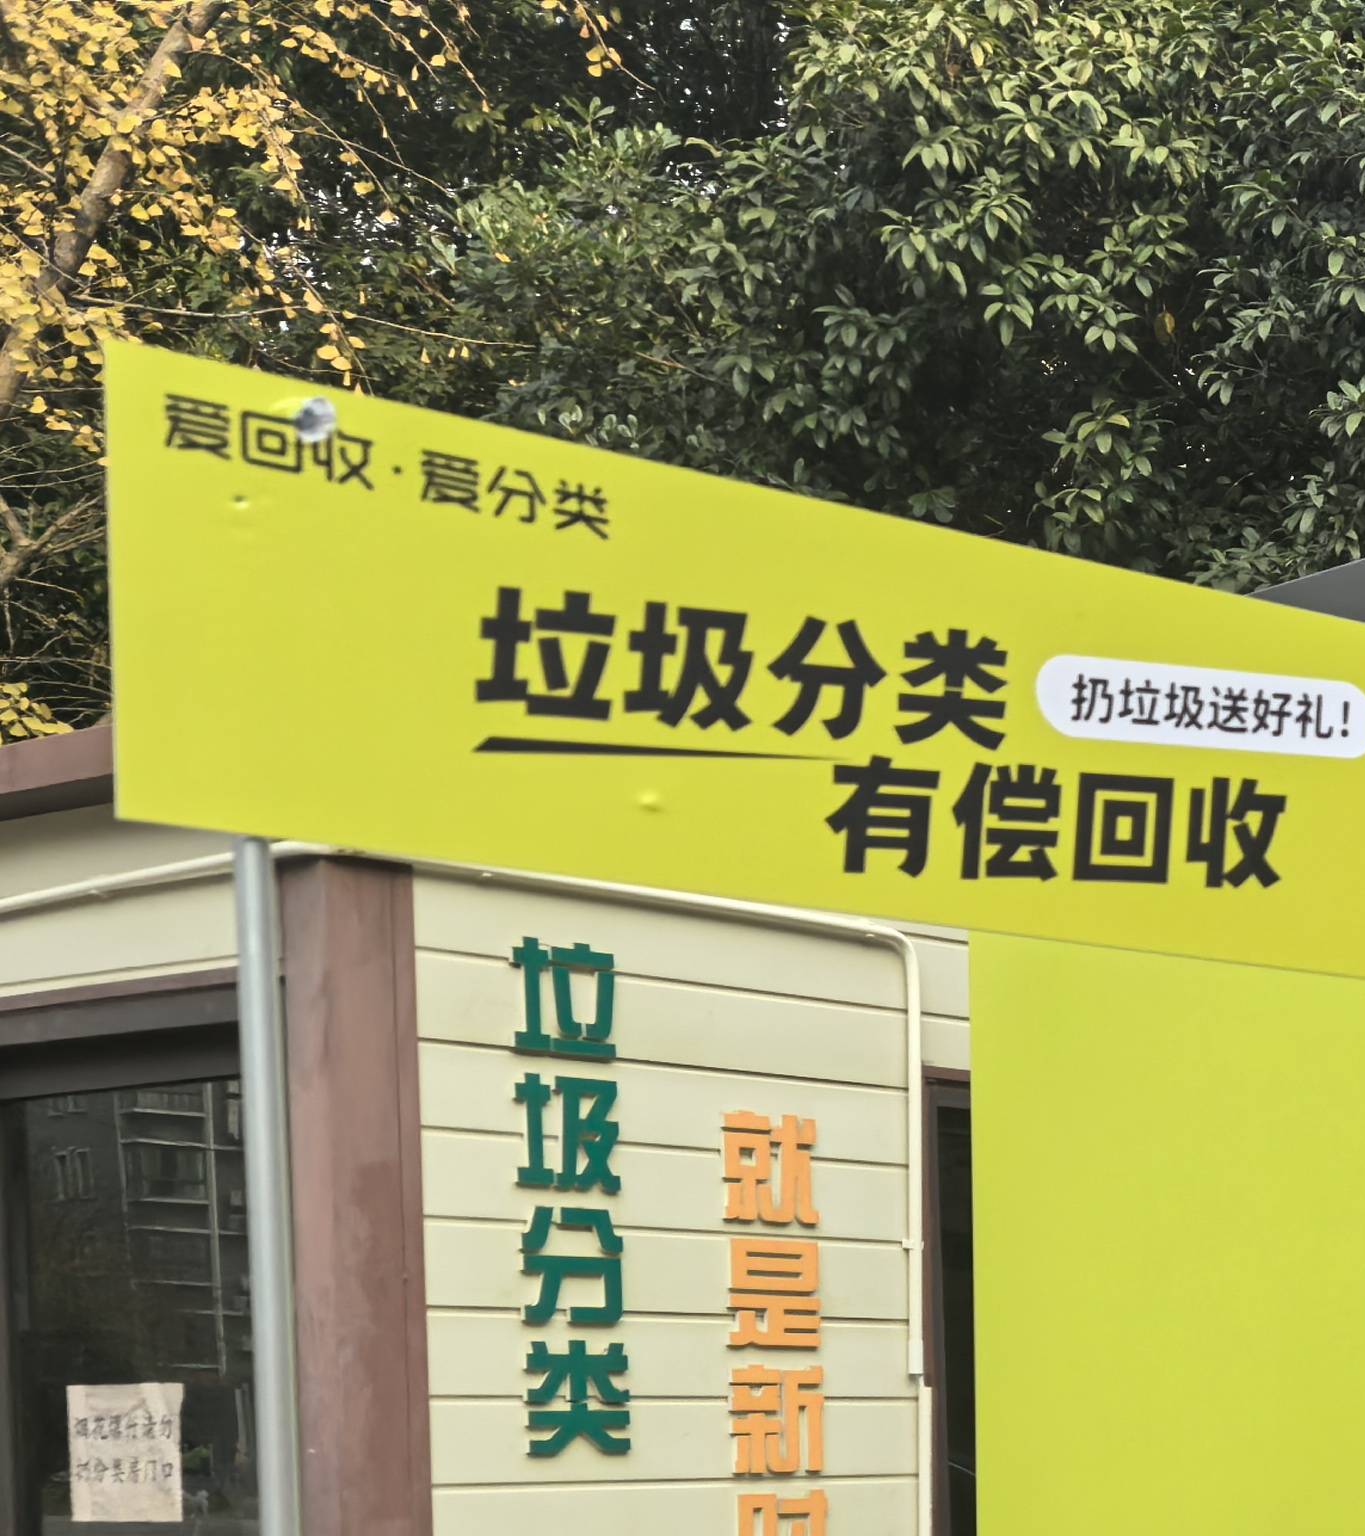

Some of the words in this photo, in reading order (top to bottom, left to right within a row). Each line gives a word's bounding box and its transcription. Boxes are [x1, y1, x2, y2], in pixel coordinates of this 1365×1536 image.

[474, 586, 1010, 751] 垃圾分类
[824, 754, 1288, 889] 有偿回收
[511, 936, 631, 1457] 垃圾分类
